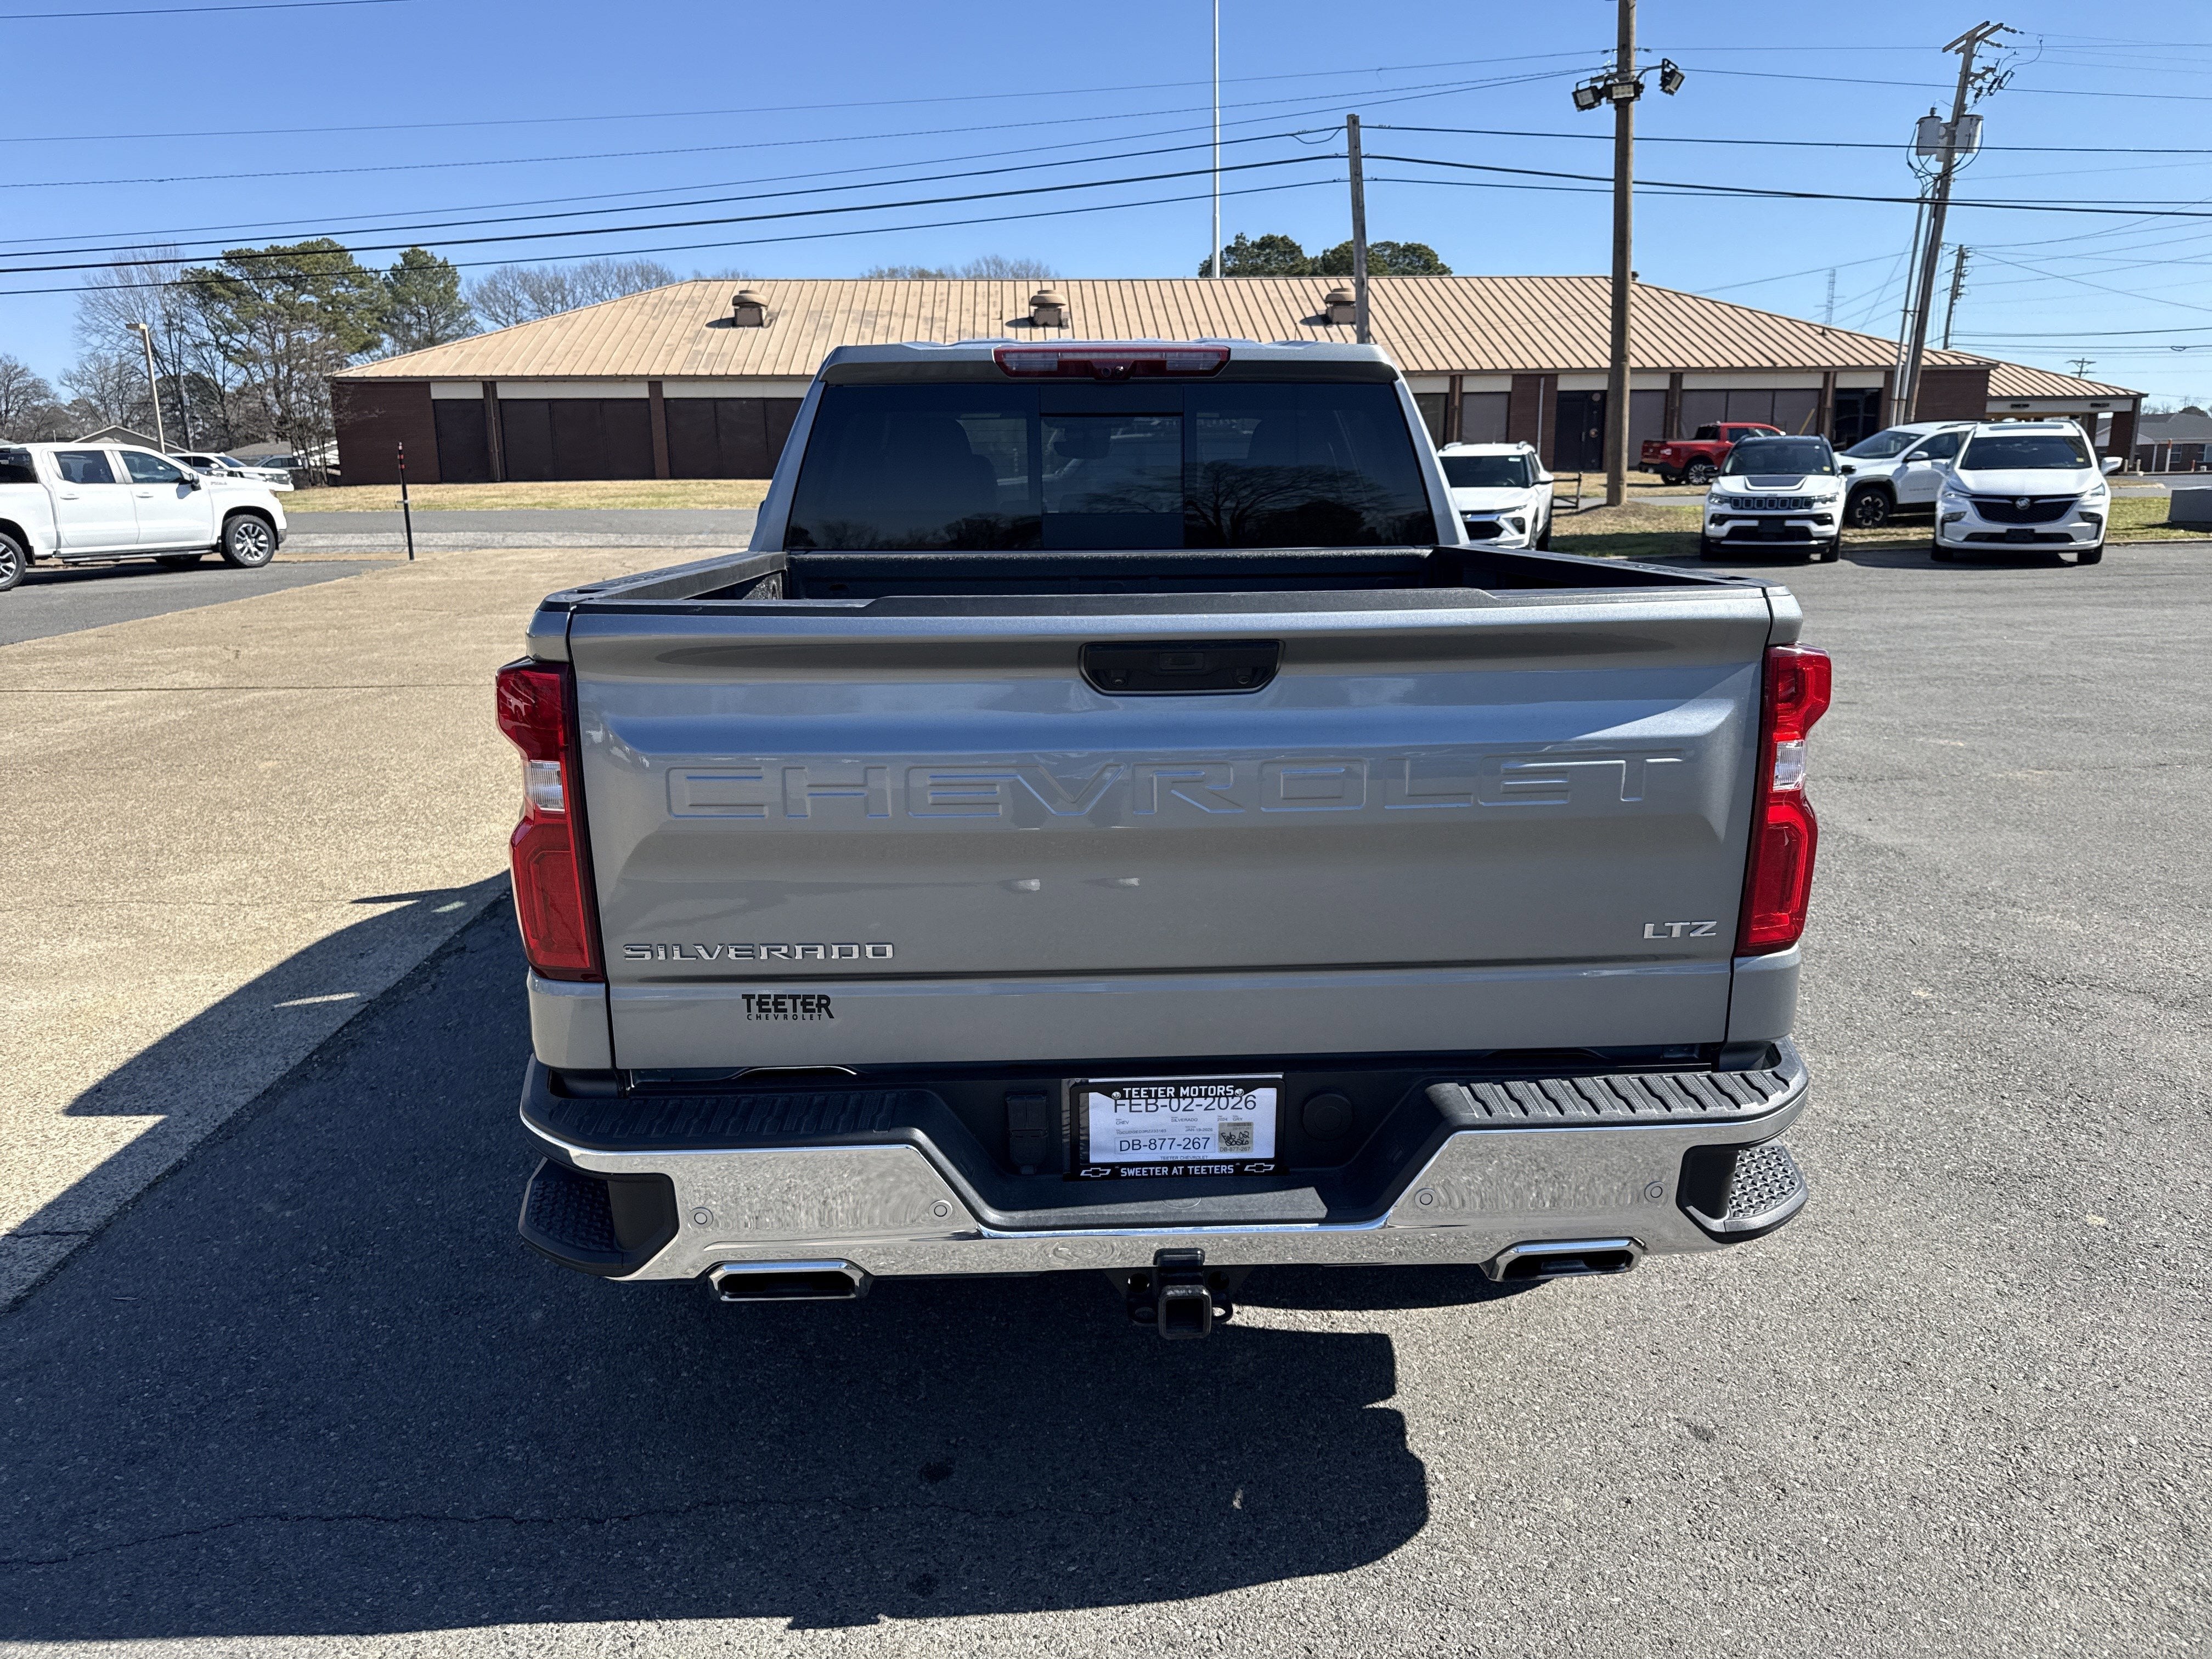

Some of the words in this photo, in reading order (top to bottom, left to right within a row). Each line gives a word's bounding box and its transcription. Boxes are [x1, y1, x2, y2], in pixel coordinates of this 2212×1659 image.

[665, 749, 1684, 819] CHEVROLET
[1644, 920, 1717, 939] LTZ
[623, 943, 894, 961] SILVERADO
[741, 994, 835, 1019] TEETER
[1122, 1087, 1175, 1098] TEETER
[1180, 1085, 1234, 1097] MOTORS
[1114, 1094, 1257, 1113] FEB-02-2026
[1120, 1137, 1210, 1152] DB-877-267
[1120, 1166, 1169, 1177] SWEETER
[1171, 1166, 1184, 1175] AT
[1187, 1165, 1234, 1175] TEETERS
